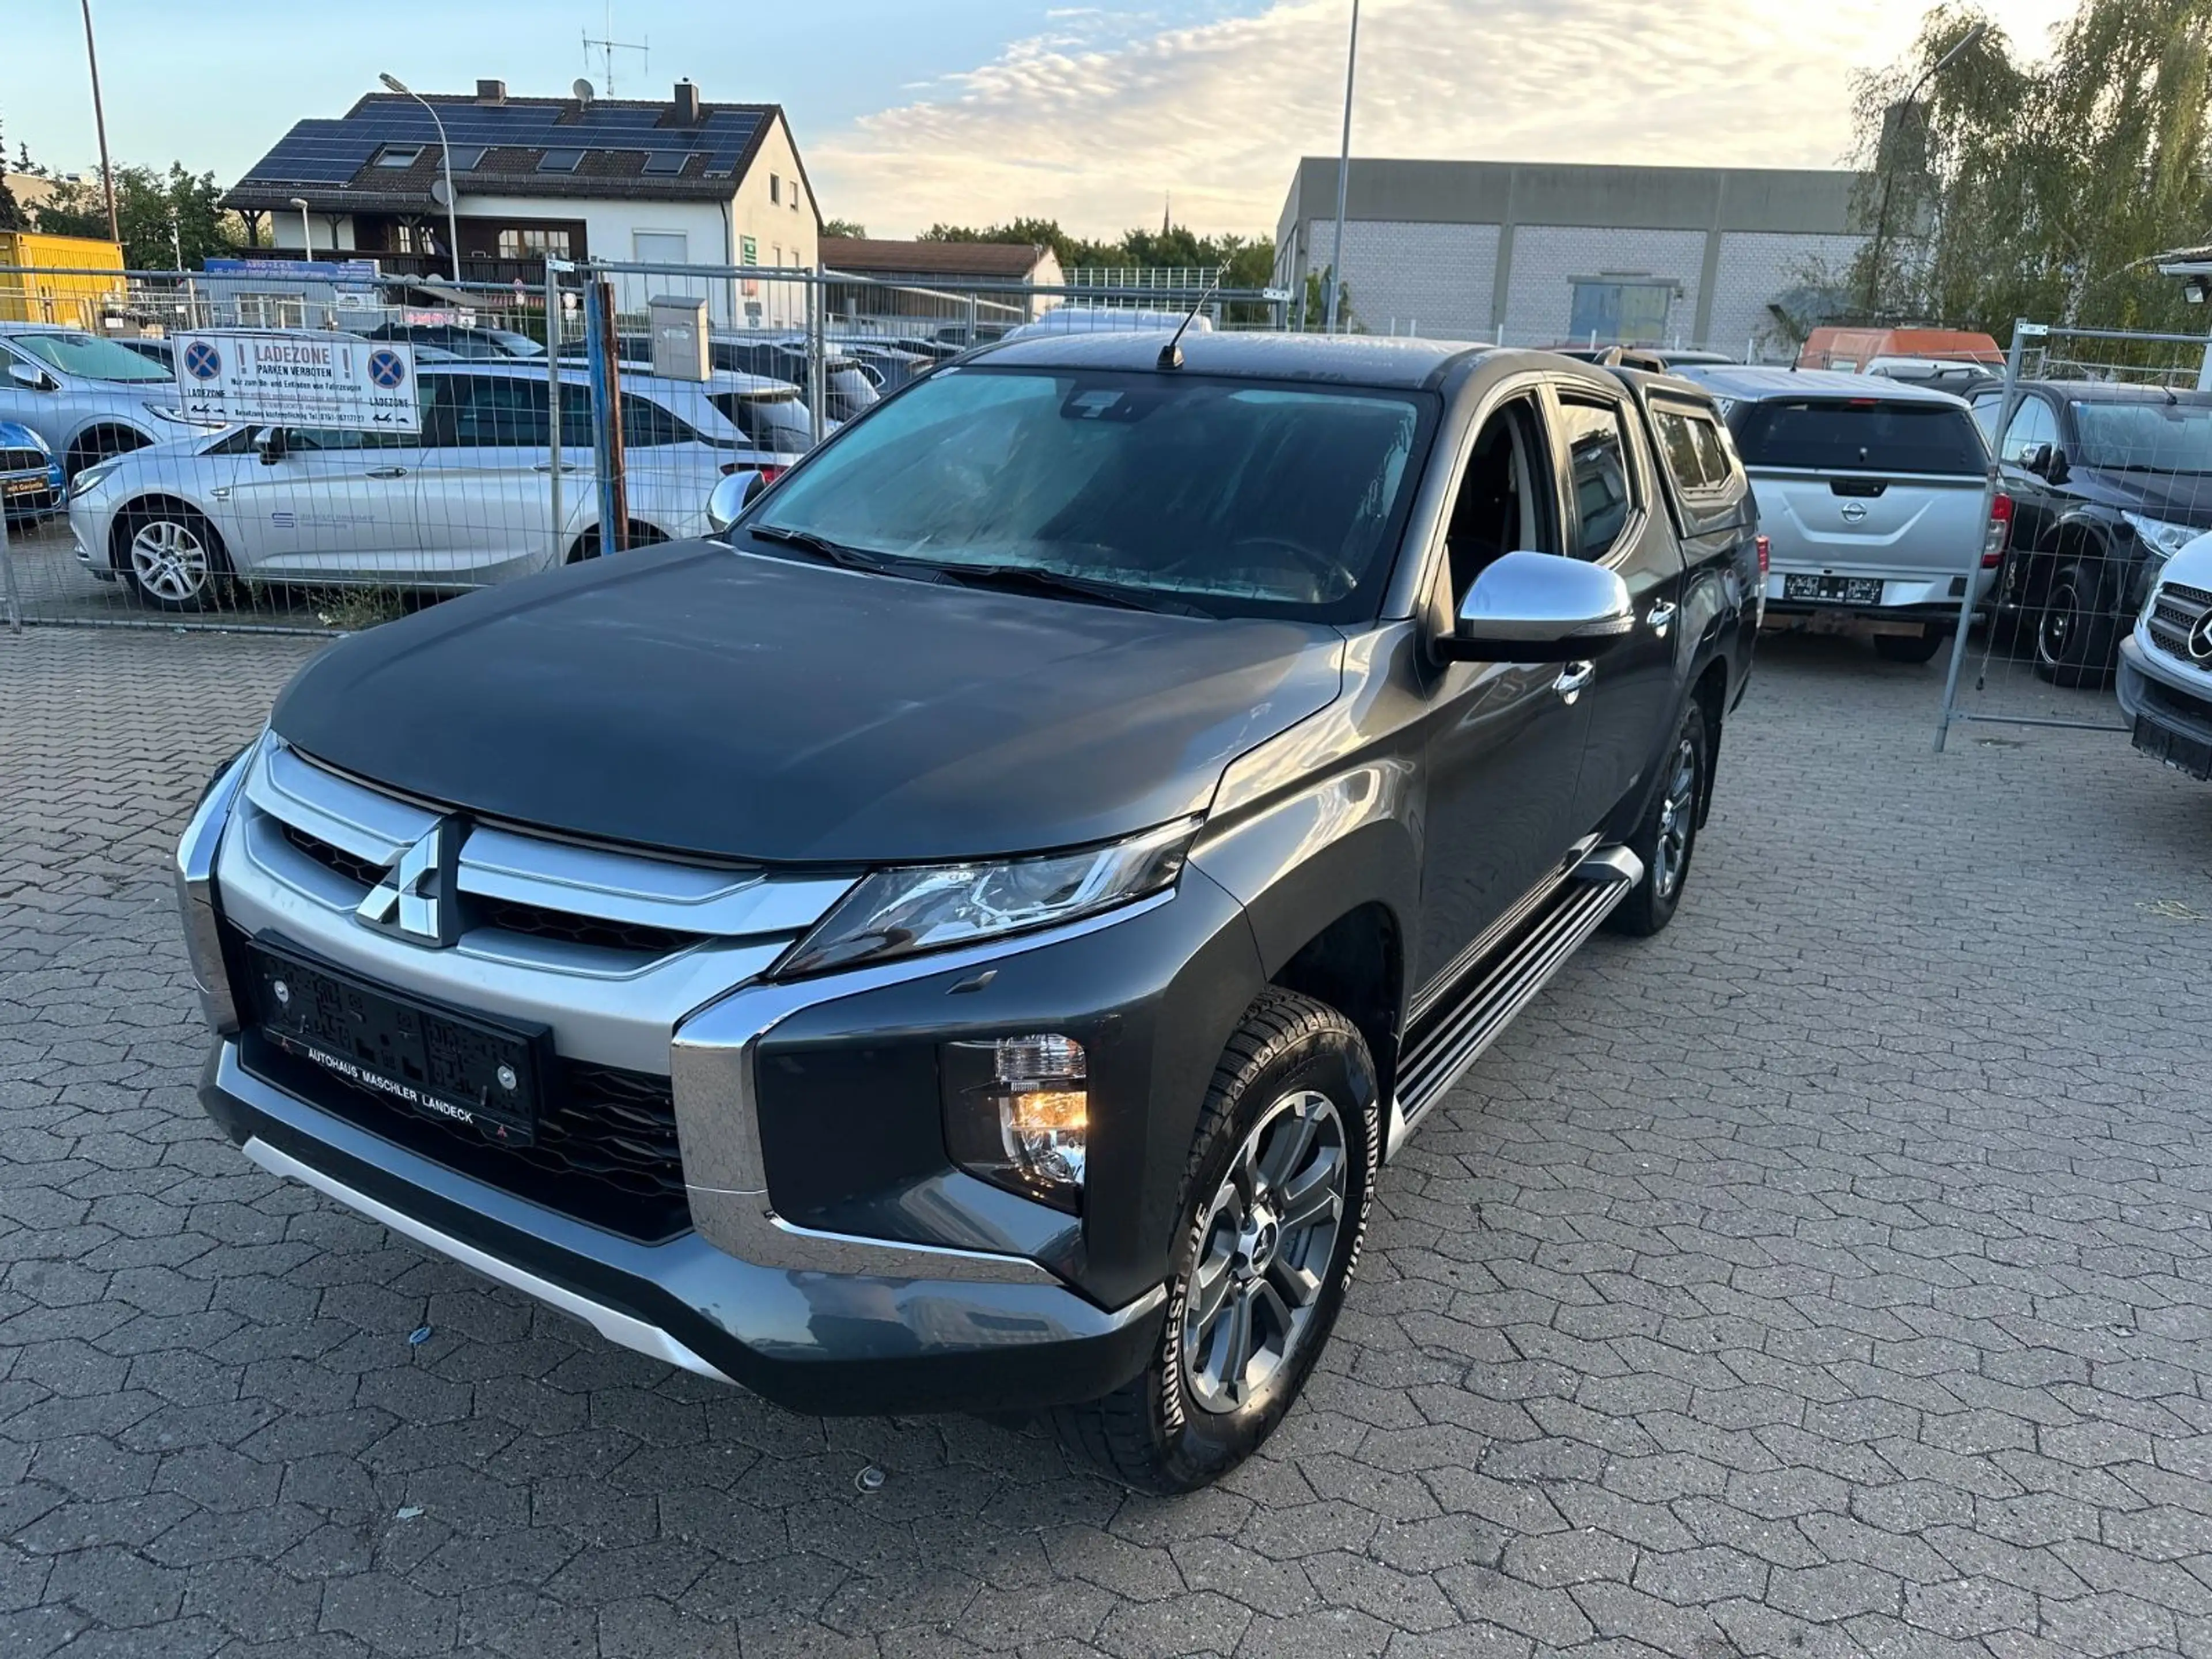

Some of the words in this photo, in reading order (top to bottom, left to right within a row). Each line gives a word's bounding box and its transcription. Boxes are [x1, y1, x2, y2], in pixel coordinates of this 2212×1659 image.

[255, 344, 330, 365] LADEZONE
[257, 364, 289, 376] PARKEN
[290, 366, 332, 377] VERBOTEN
[187, 388, 225, 397] LADEZONE
[369, 397, 408, 408] LADEZONE
[308, 1048, 358, 1078] AUTOHAUS
[362, 1070, 418, 1102] MASCHLER
[422, 1094, 473, 1124] LANDECK
[1341, 1098, 1378, 1293] BRIDGESTONE
